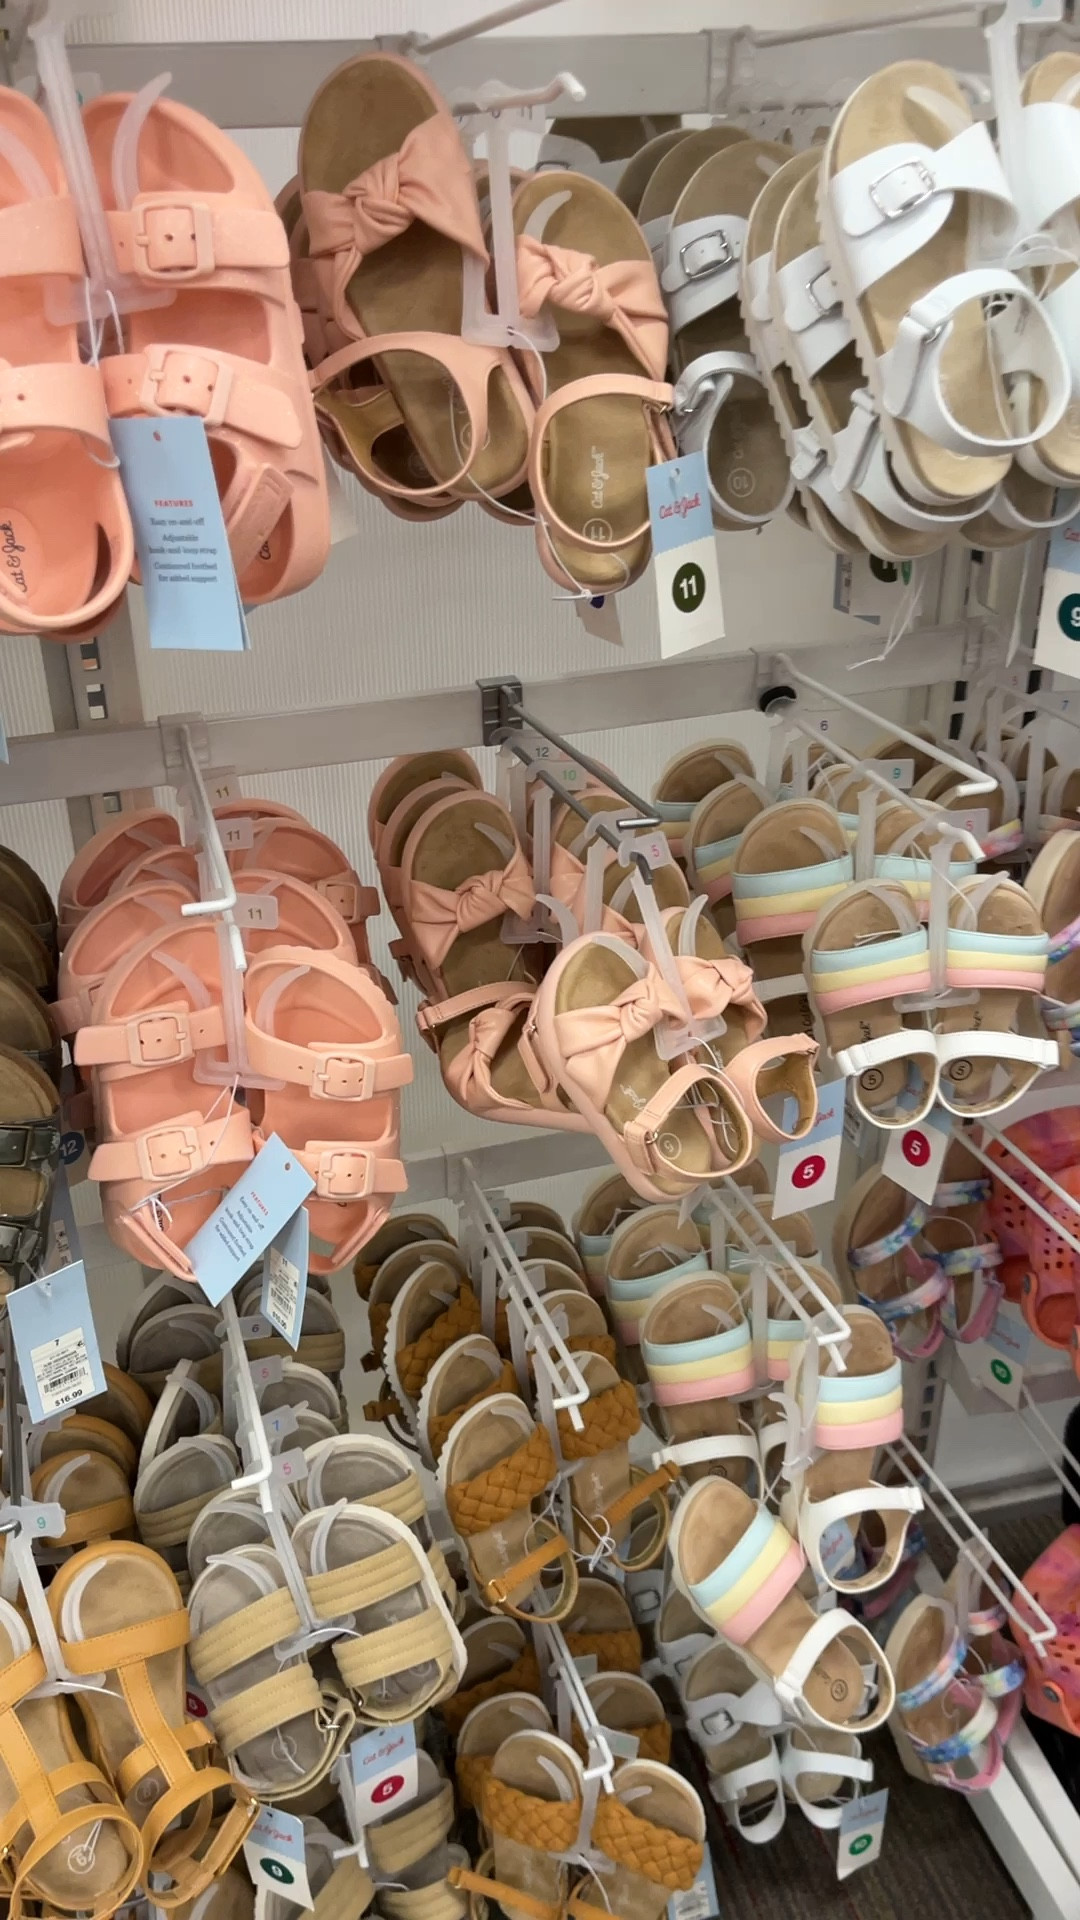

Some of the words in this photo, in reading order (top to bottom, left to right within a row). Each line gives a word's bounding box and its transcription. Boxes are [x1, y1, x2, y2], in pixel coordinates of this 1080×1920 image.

[154, 499, 194, 508] FEATURES
[659, 504, 673, 519] Cat
[681, 493, 702, 519] Jack
[679, 575, 697, 600] 11
[819, 720, 829, 731] 6
[535, 746, 549, 758] 12
[562, 769, 577, 781] 10
[893, 767, 901, 779] 9
[215, 786, 230, 799] 11
[965, 820, 974, 831] 5
[226, 829, 241, 842] 11
[650, 844, 660, 858] 5
[247, 907, 263, 921] 11
[60, 1139, 79, 1157] 12
[909, 1139, 922, 1157] 5
[803, 1163, 815, 1180] 5
[250, 1191, 269, 1217] FEATURES
[251, 1324, 260, 1333] 6
[261, 1368, 269, 1380] 5
[54, 1388, 83, 1407] $16.99
[37, 1516, 46, 1529] 9
[382, 1782, 393, 1795] 5
[272, 1864, 283, 1878] 9
